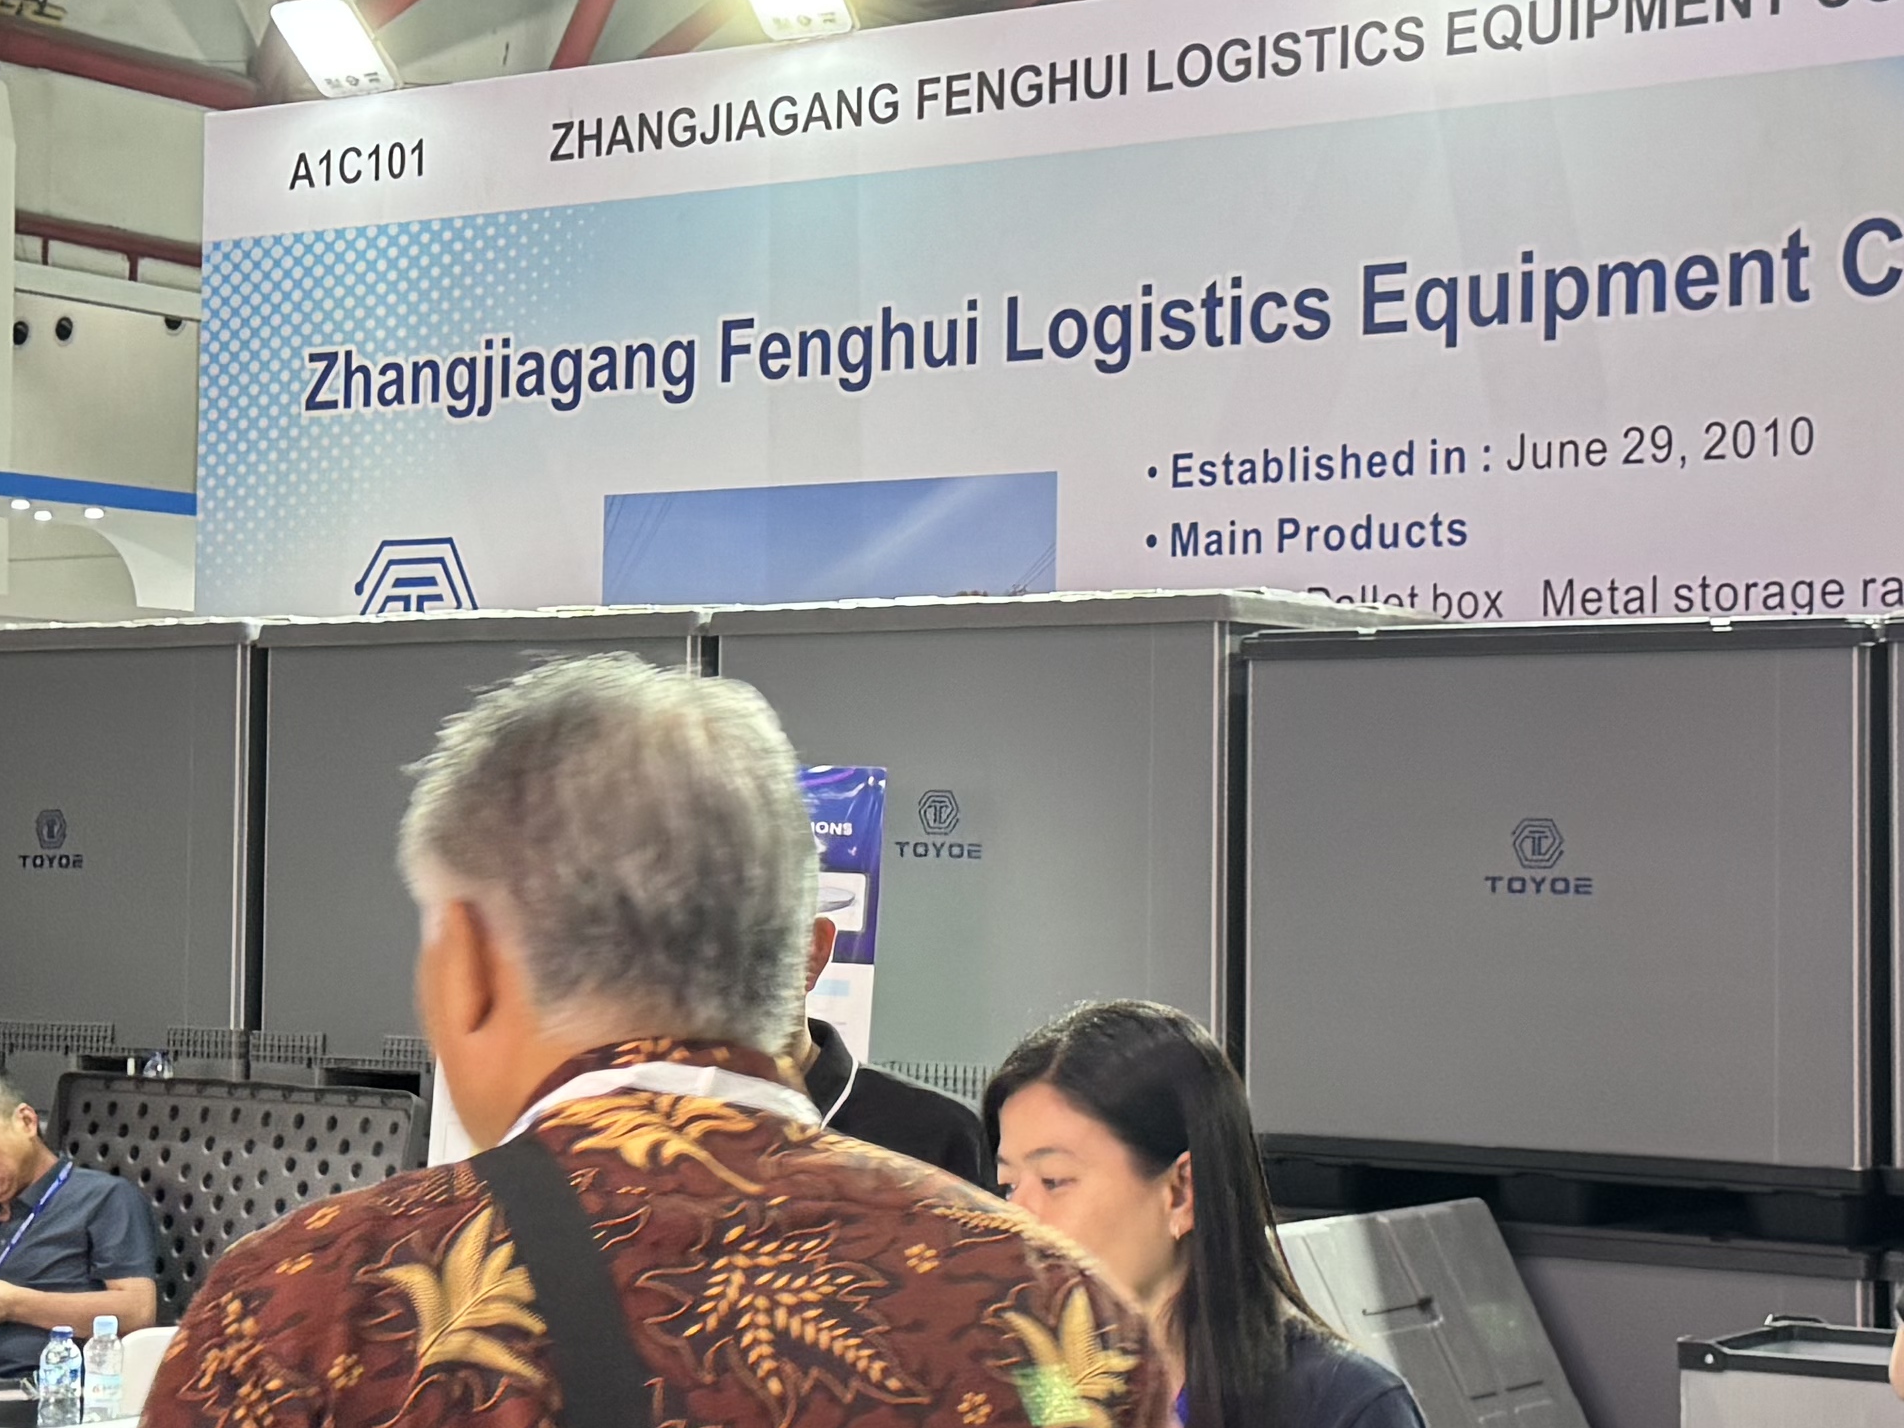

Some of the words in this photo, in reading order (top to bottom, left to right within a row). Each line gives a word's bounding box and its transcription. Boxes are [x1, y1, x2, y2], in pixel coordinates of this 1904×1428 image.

[288, 139, 427, 192] A1C101
[549, 82, 900, 163] ZHANGJIAGANG
[915, 52, 1129, 122] FENGHUI
[1145, 13, 1426, 95] LOGISTICS
[304, 330, 697, 419] Zhangjiagang
[718, 298, 980, 393] Fenghui
[1004, 274, 1332, 374] Logistics
[1360, 227, 1811, 348] Equipment
[1172, 438, 1414, 489] Established
[1428, 438, 1467, 476] in
[1506, 430, 1609, 473] June
[1620, 424, 1688, 470] 29,
[1703, 415, 1816, 463] 2010
[1170, 518, 1263, 558] Main
[1276, 511, 1469, 554] Products
[1432, 582, 1504, 620] box
[1541, 576, 1659, 619] Metal
[1673, 571, 1846, 616] storage
[18, 854, 84, 870] TOYOE
[895, 840, 983, 860] TOYOE
[1484, 874, 1594, 896] TOYOE
